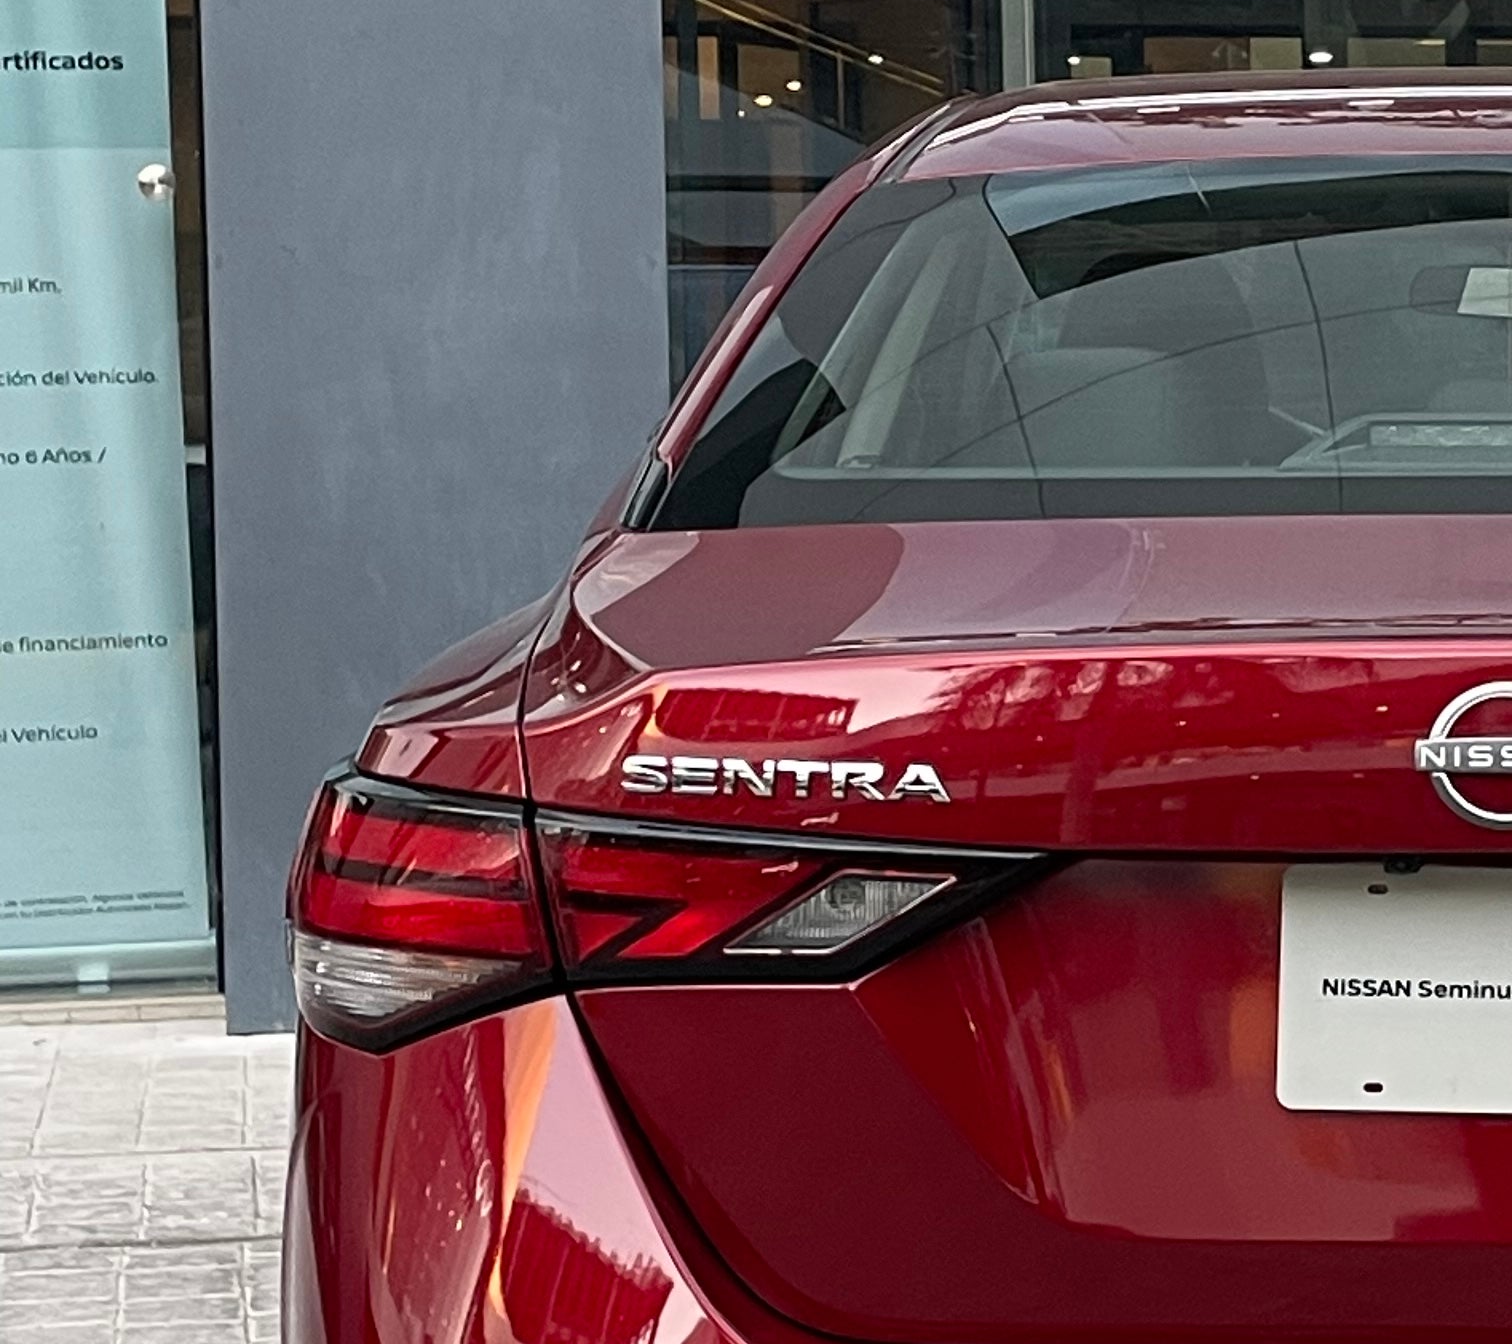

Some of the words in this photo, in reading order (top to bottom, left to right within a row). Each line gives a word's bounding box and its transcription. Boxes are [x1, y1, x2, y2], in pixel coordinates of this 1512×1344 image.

[41, 370, 70, 386] del
[42, 447, 92, 464] Años
[19, 633, 168, 652] financiamiento
[11, 724, 98, 743] Vehículo
[620, 754, 951, 803] SENTRA
[1322, 978, 1412, 998] NISSAN
